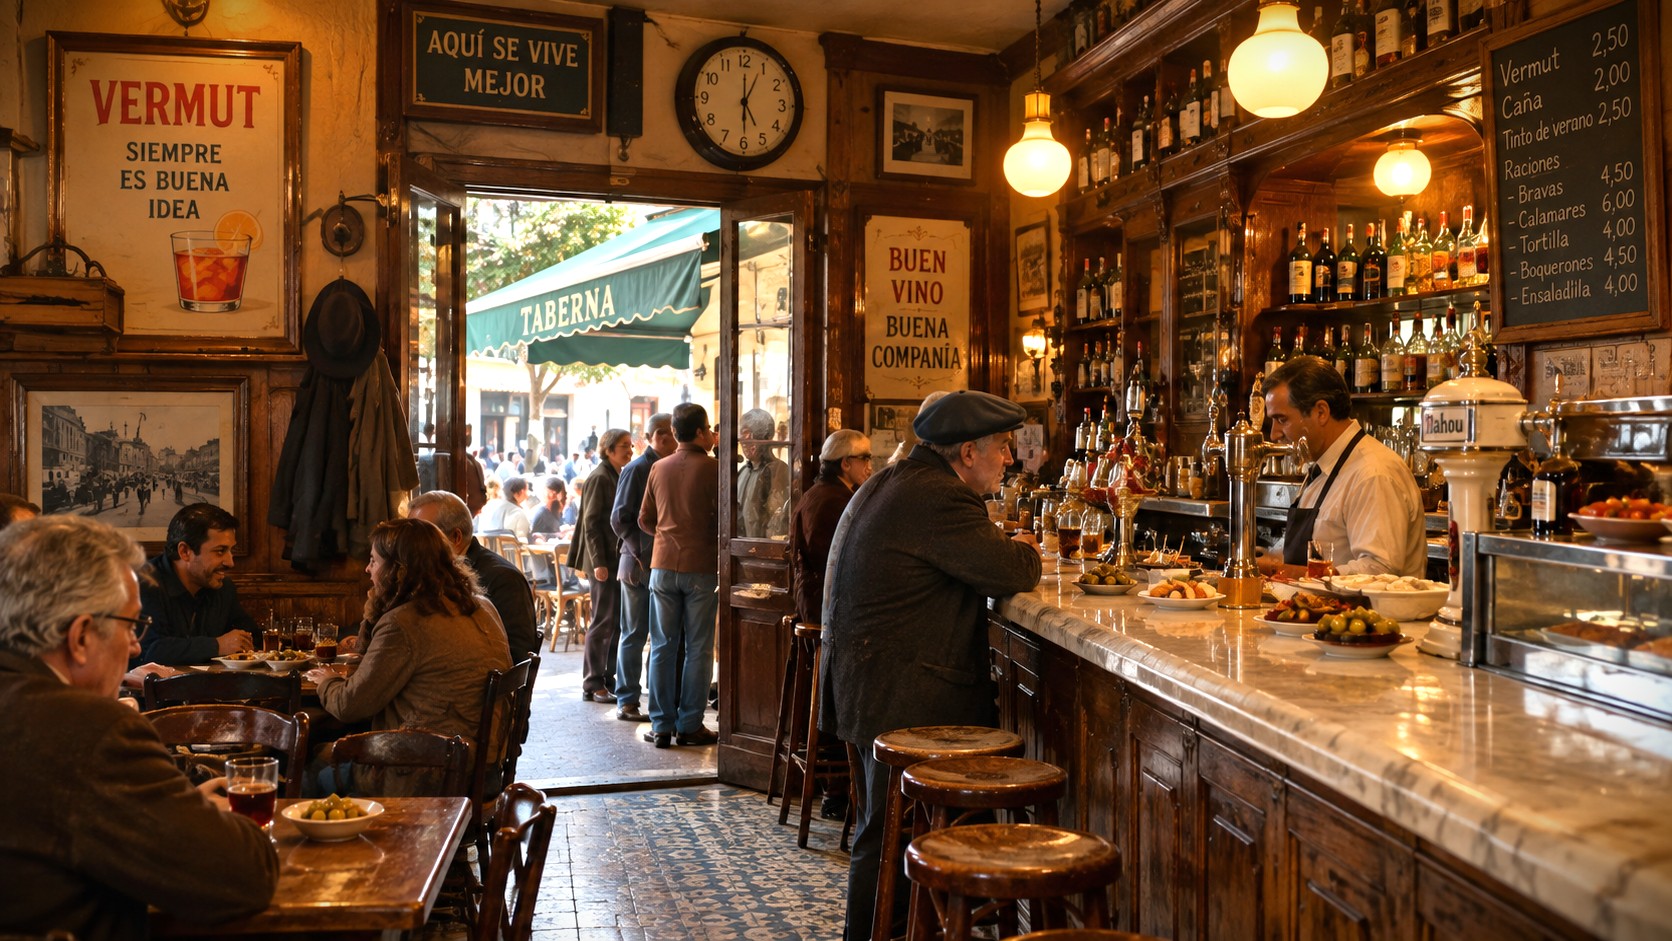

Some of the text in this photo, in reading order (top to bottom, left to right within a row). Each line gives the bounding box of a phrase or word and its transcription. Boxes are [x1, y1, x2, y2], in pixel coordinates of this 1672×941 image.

[427, 28, 578, 67] AQUÍ SE VIVE
[1500, 24, 1628, 87] Vermut 2,50
[721, 59, 730, 72] 11
[739, 55, 751, 68] 12
[761, 62, 765, 75] 1
[464, 68, 546, 99] MEJOR
[706, 72, 719, 86] 10
[773, 78, 781, 92] 2
[1502, 61, 1630, 119] Caña 2,00
[89, 79, 261, 128] VERMUT
[700, 91, 709, 104] 9
[778, 99, 786, 113] 3
[706, 113, 715, 126] 8
[772, 120, 780, 132] 4
[1503, 96, 1632, 150] Tinto de verano 2,50
[721, 130, 729, 142] 7
[740, 136, 748, 150] 6
[758, 133, 766, 145] 5
[126, 142, 222, 164] SIEMPRE
[1505, 155, 1560, 180] Raciones
[120, 170, 229, 192] ES BUENA
[1518, 182, 1564, 204] Bravas
[1600, 161, 1634, 187] 4,50
[149, 199, 200, 219] IDEA
[1518, 203, 1586, 228] Calamares
[1602, 189, 1635, 216] 6,00
[1520, 229, 1569, 254] Tortilla
[1603, 216, 1636, 242] 4,00
[889, 247, 946, 274] BUEN
[1520, 256, 1594, 282] Boquerones
[1604, 244, 1637, 270] 4,50
[891, 280, 944, 305] VINO
[1604, 273, 1638, 297] 4,00
[521, 284, 615, 336] TABERNA
[886, 315, 949, 338] BUENA
